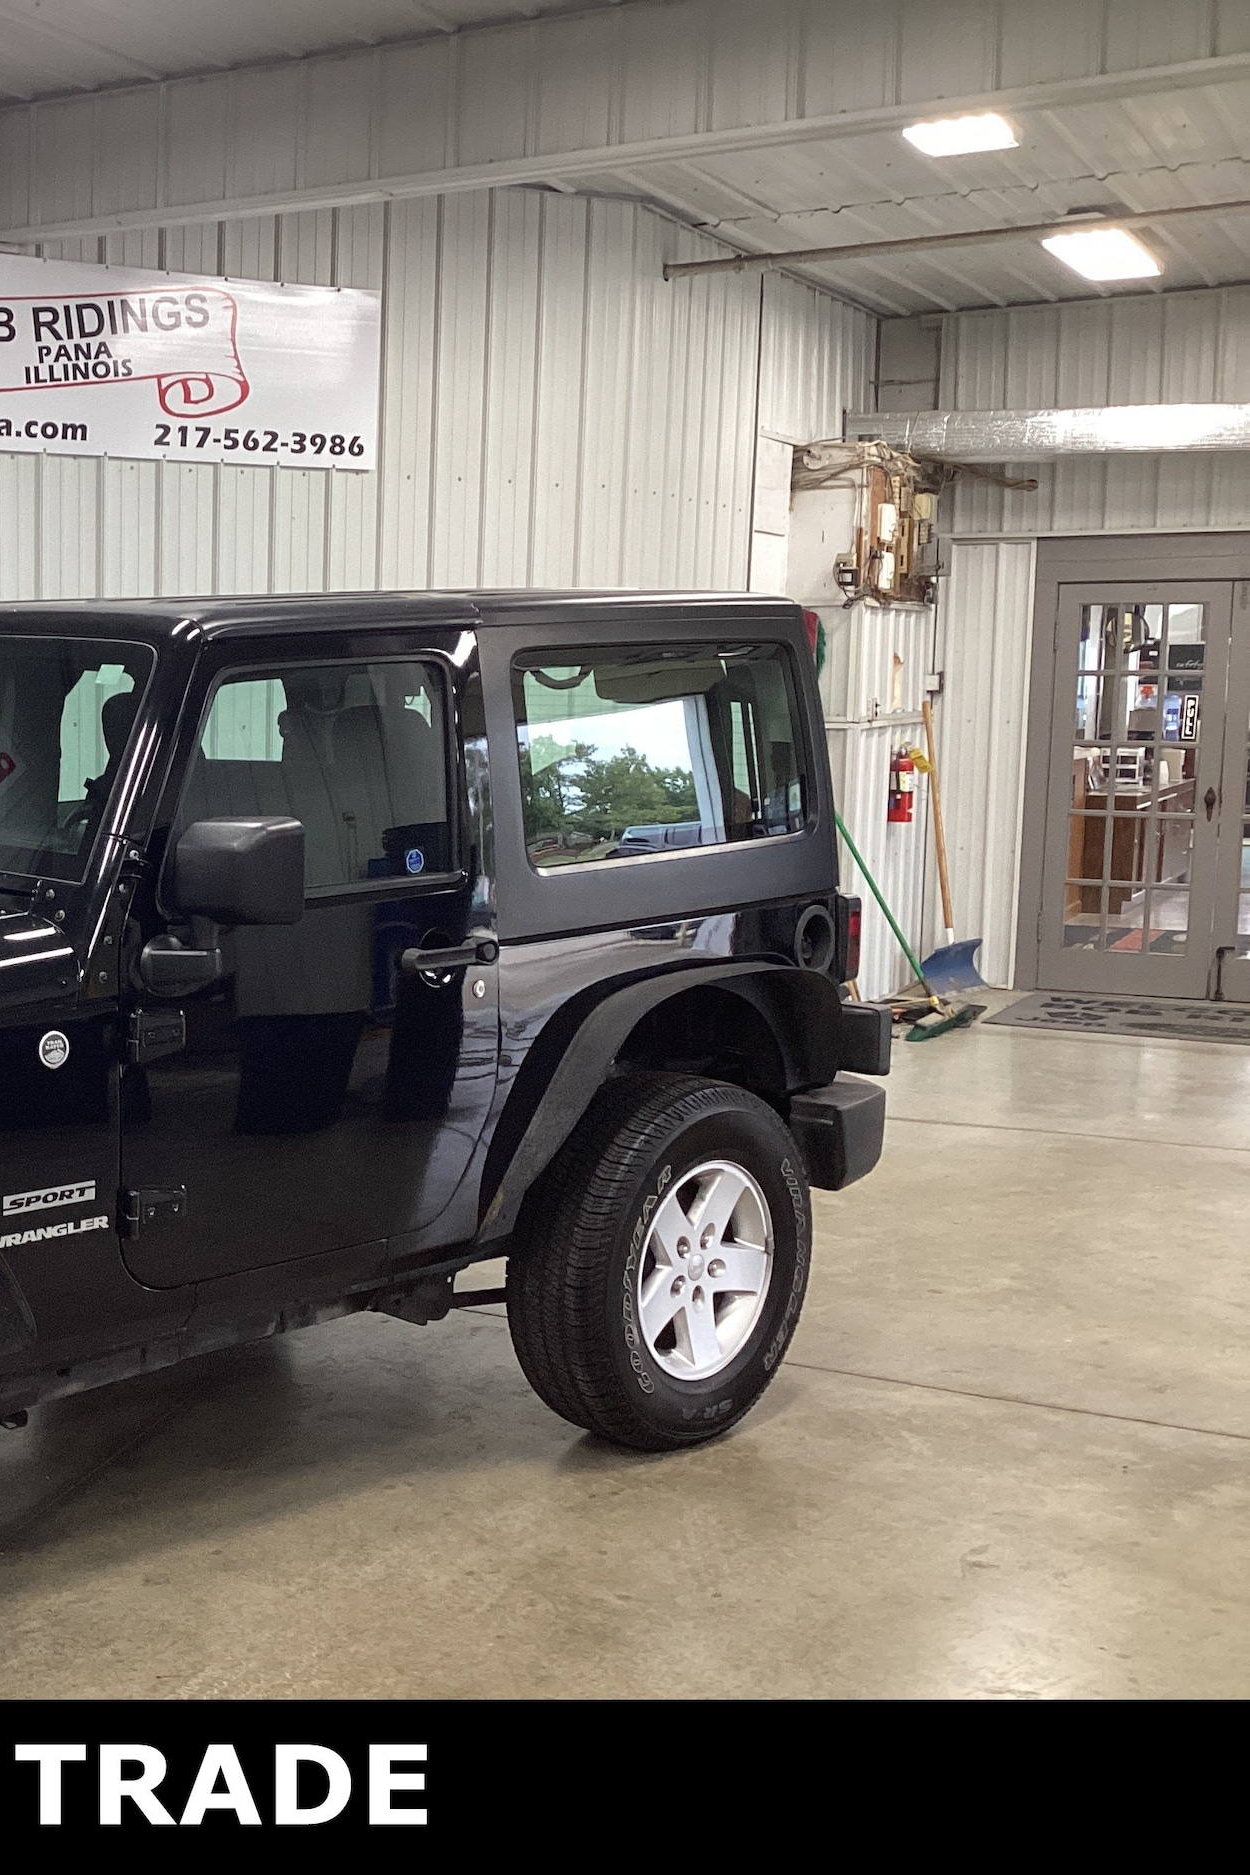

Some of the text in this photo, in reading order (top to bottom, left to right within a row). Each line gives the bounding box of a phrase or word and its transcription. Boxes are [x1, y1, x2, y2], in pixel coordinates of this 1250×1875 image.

[31, 293, 211, 343] RIDINGS
[37, 341, 113, 365] PANA
[24, 358, 134, 385] ILLINOIS
[153, 422, 367, 459] 217-562-3986
[1185, 699, 1196, 735] PULL
[9, 1186, 89, 1209] SPORT
[622, 1164, 673, 1394] GOODYEAR
